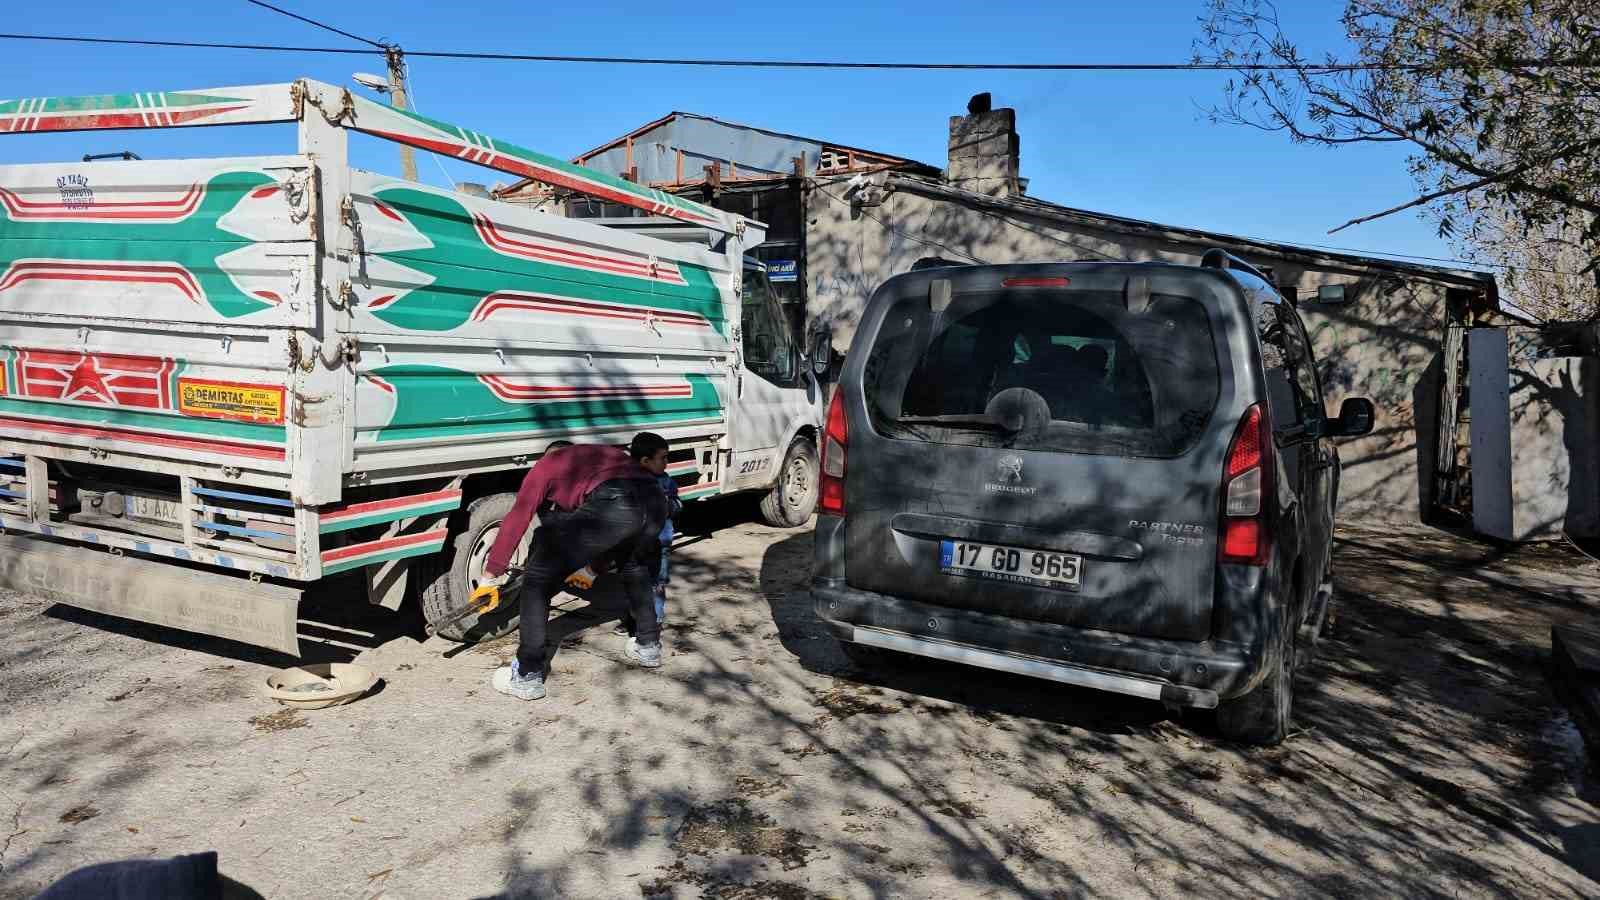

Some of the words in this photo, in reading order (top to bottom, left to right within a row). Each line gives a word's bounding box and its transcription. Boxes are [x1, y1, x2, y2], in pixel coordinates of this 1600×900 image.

[984, 483, 1038, 496] PEUGEOT
[1128, 520, 1205, 534] PARTNER
[958, 543, 982, 567] 17
[991, 547, 1021, 572] GD
[1030, 552, 1077, 580] 965
